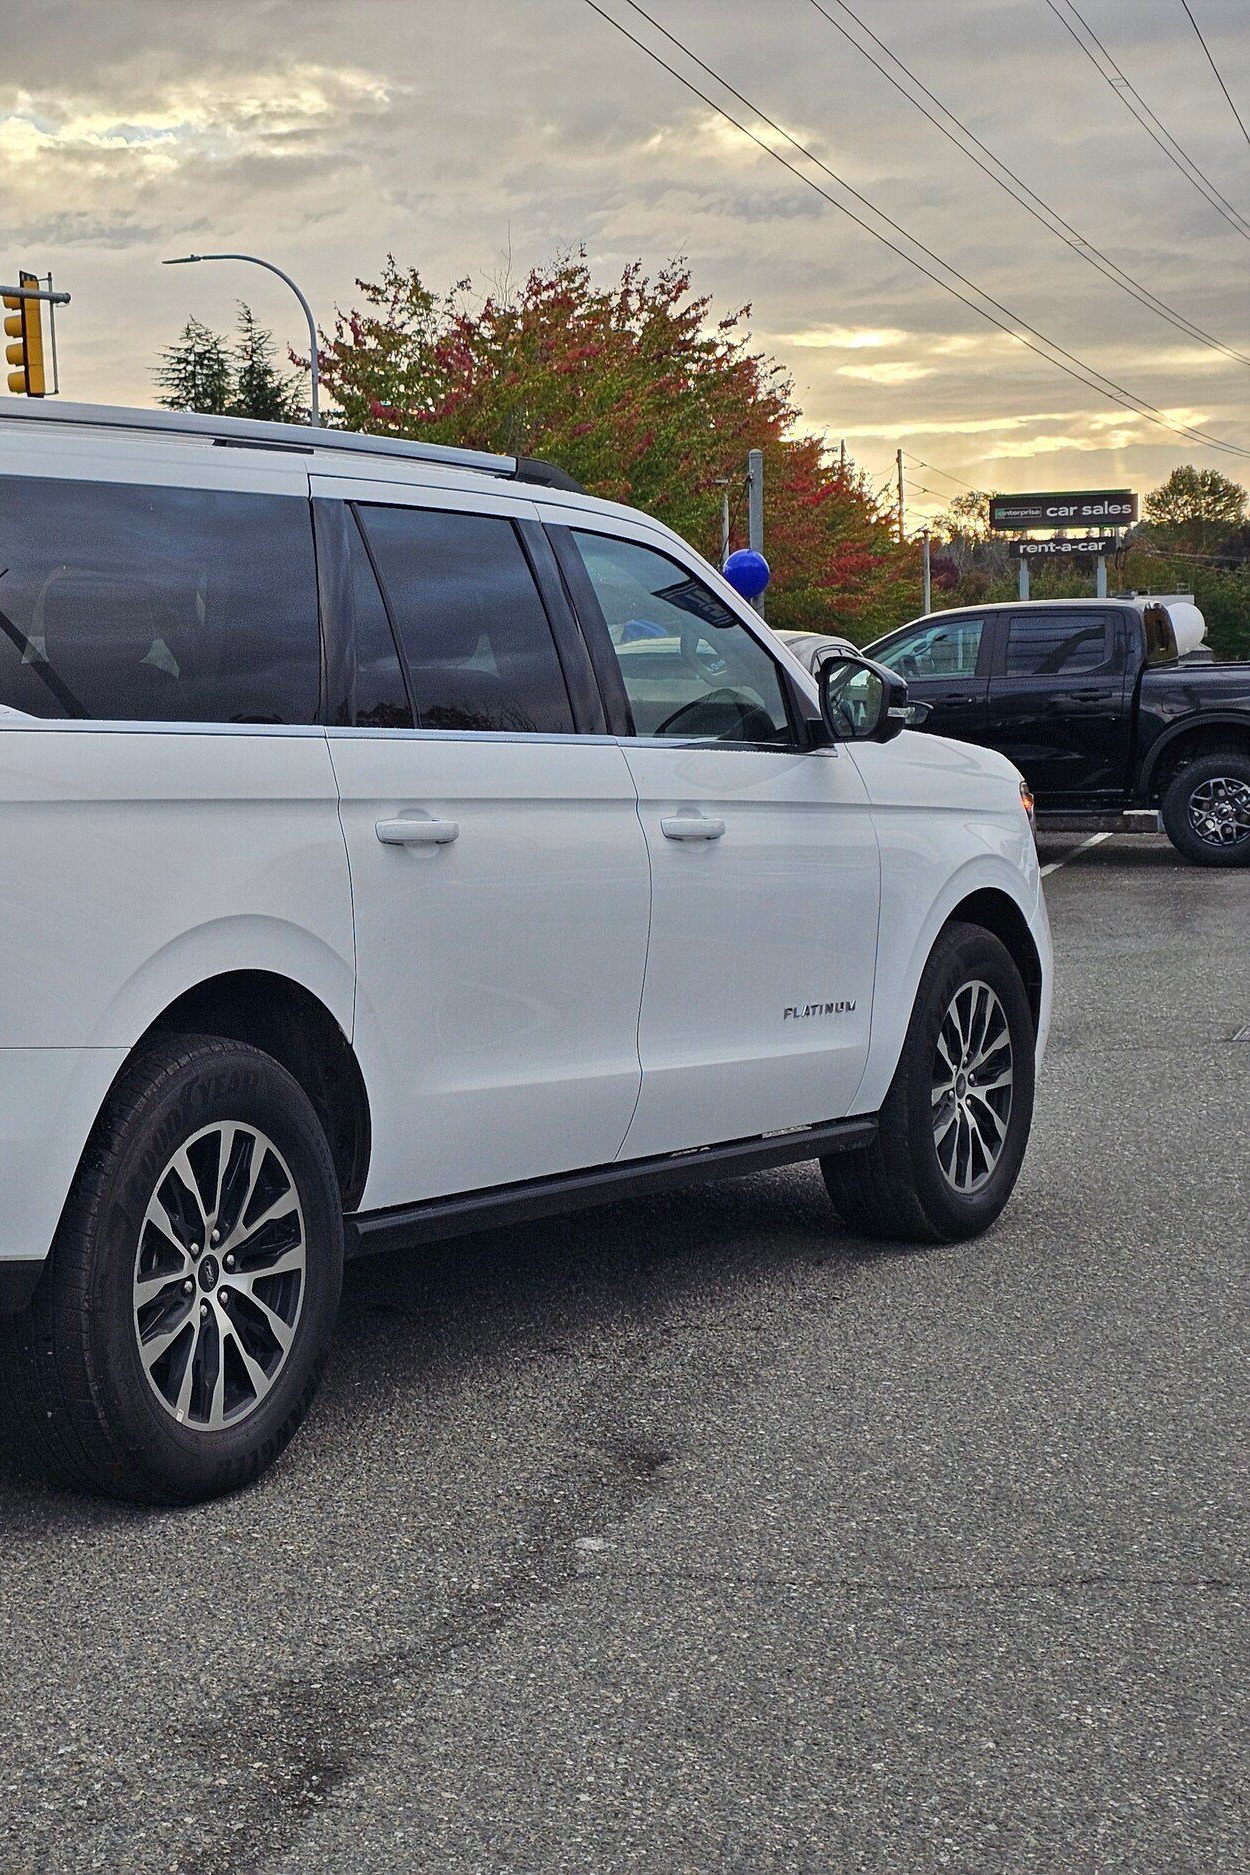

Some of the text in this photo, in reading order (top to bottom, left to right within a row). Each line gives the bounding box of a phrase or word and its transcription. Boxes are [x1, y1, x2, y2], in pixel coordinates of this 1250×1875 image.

[1046, 506, 1078, 517] car
[1082, 501, 1132, 515] sales
[1019, 541, 1107, 554] rent-a-car
[783, 1000, 856, 1020] PLATINUM
[125, 1071, 259, 1205] GOODYEAR
